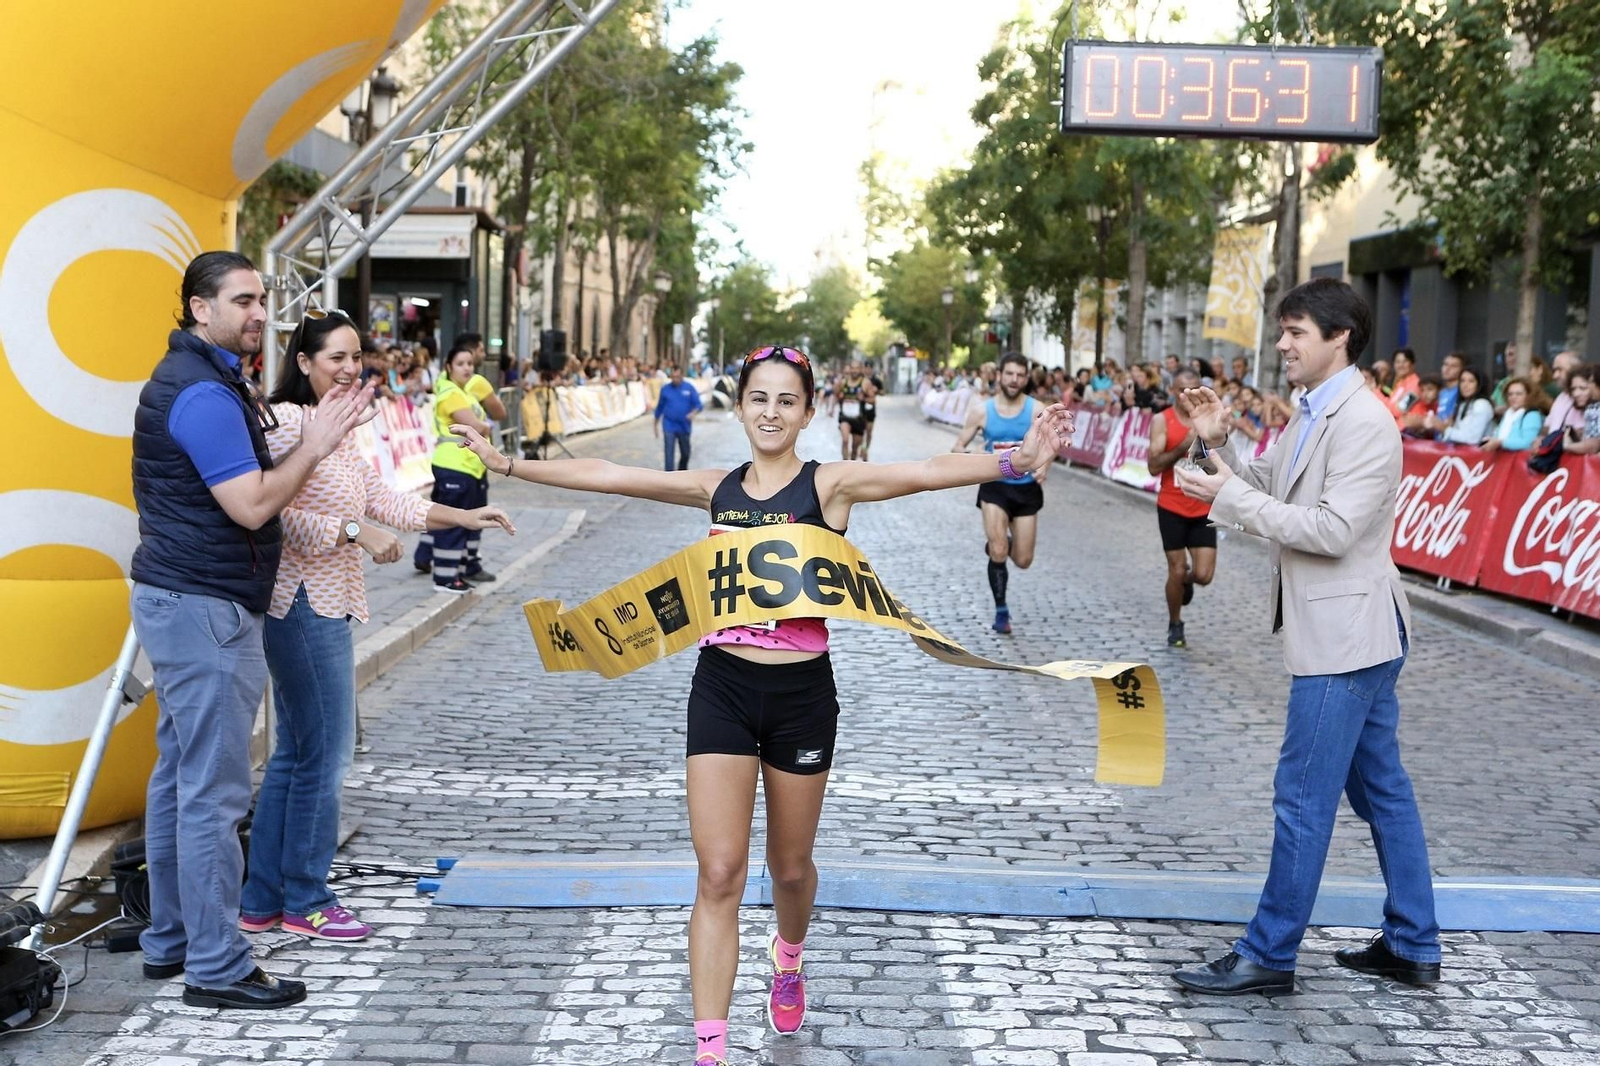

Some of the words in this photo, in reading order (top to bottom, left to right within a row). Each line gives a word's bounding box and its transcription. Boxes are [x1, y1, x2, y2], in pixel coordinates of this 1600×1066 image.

[716, 510, 750, 523] ENTRENA
[762, 512, 795, 524] MEJORA
[1503, 467, 1600, 597] Coca-Co
[613, 601, 638, 625] IMD
